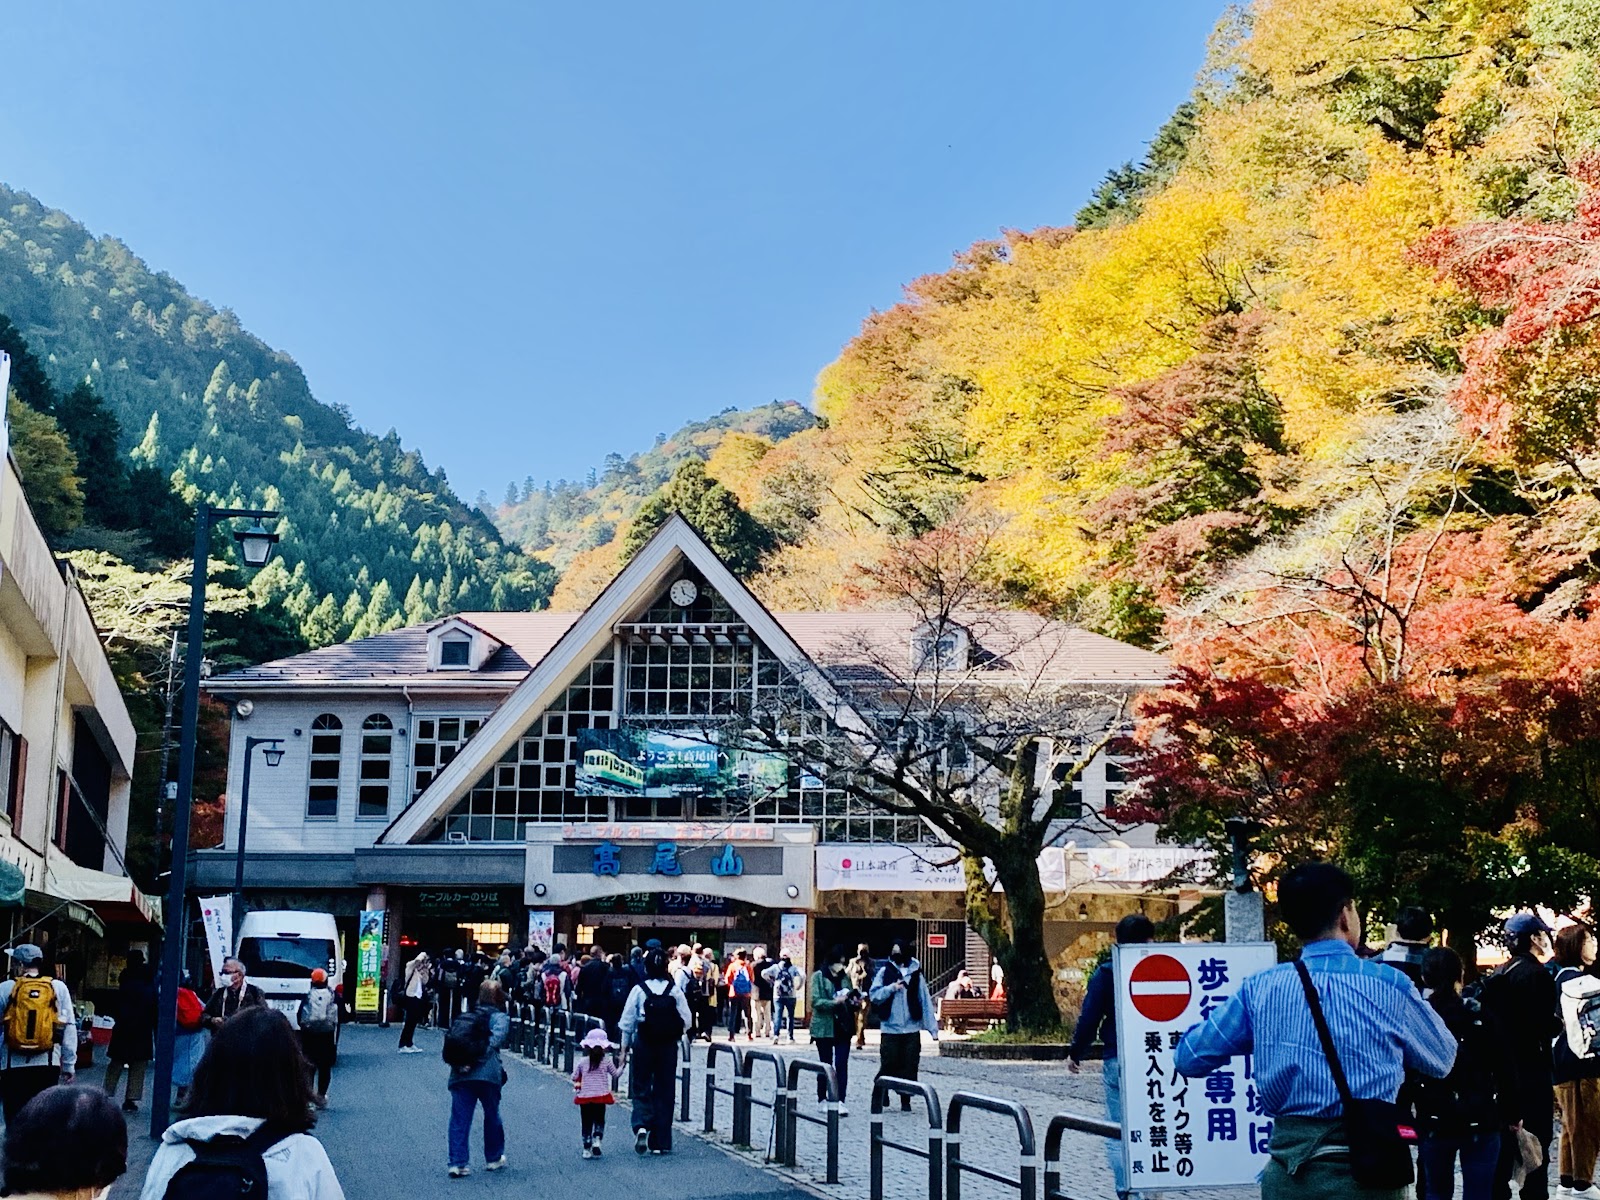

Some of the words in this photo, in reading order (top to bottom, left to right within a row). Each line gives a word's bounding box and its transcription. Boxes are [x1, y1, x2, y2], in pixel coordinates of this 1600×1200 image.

[563, 825, 657, 839] ケーブルカー
[663, 892, 692, 904] リフト
[1144, 1031, 1170, 1173] 乗入れを禁止
